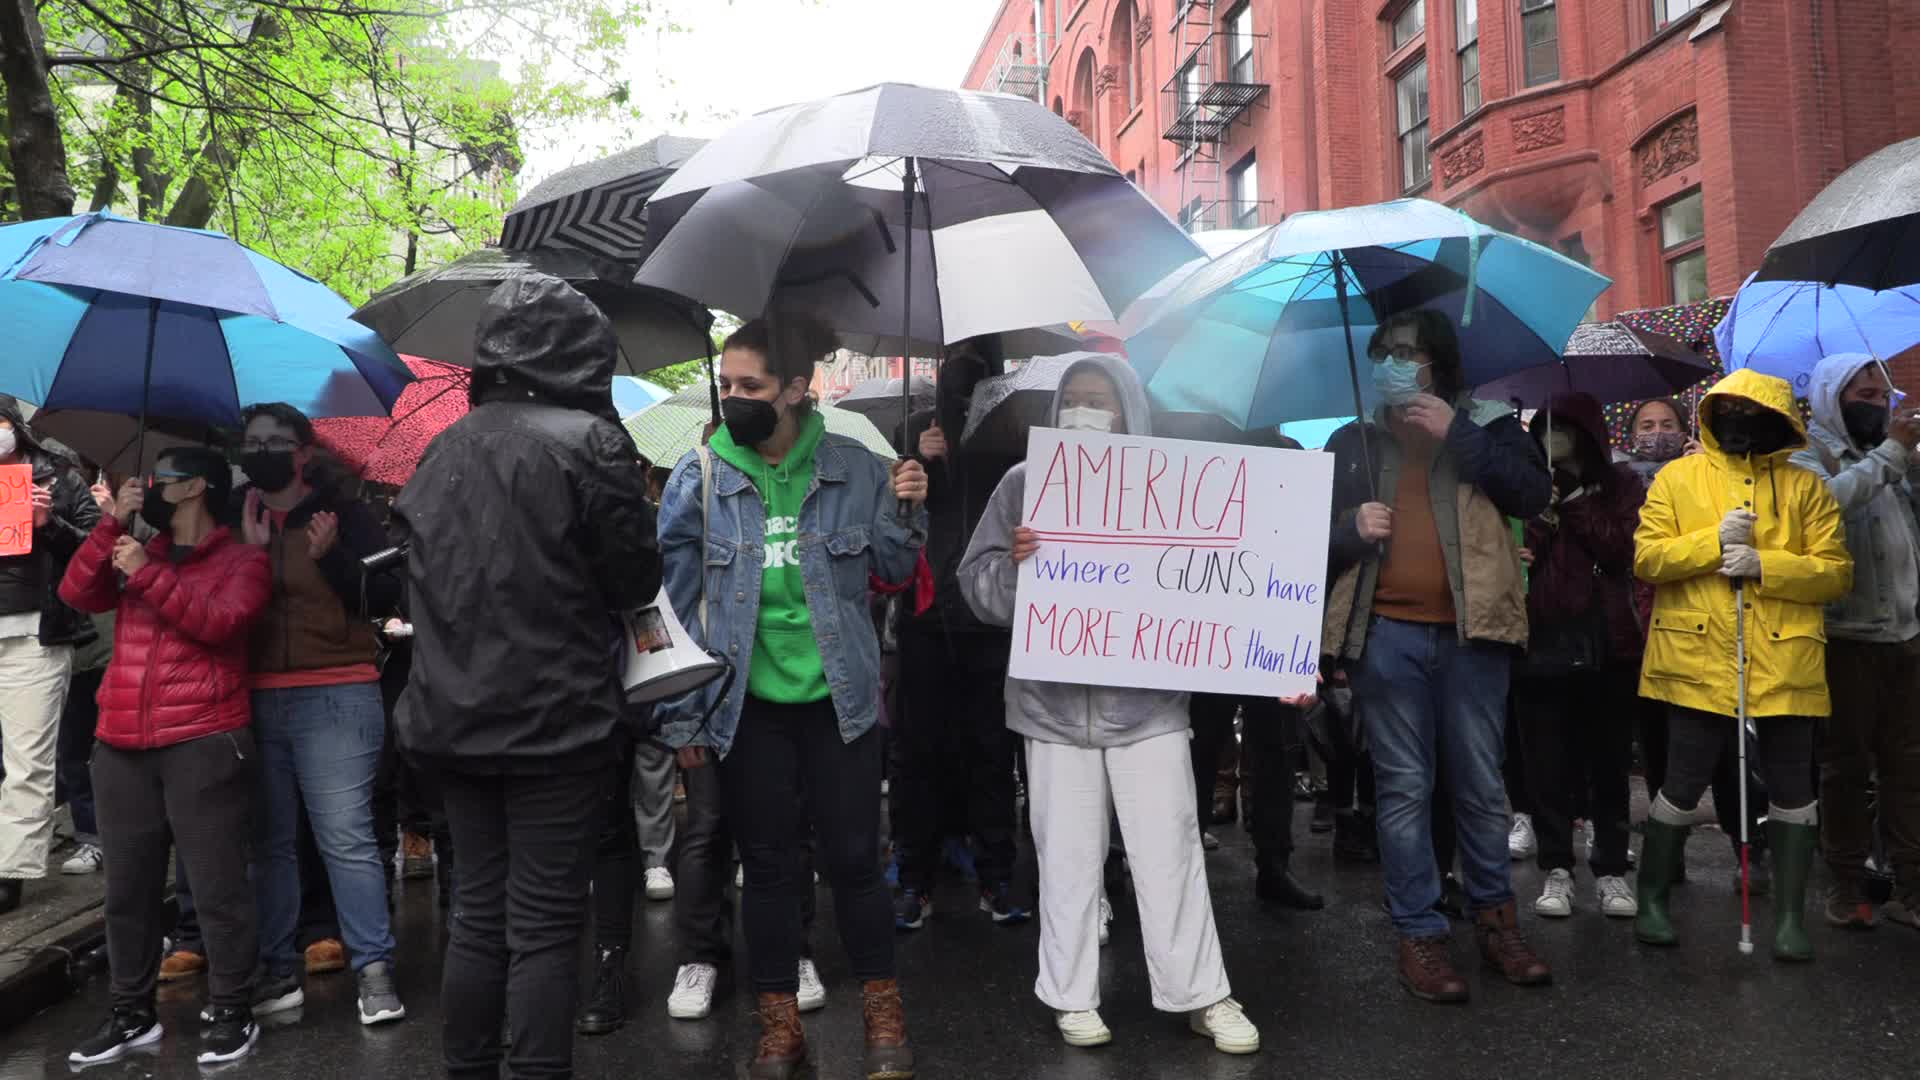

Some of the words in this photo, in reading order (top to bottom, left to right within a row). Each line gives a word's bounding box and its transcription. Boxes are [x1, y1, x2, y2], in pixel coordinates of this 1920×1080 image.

[1029, 441, 1246, 537] AMERICA
[1035, 549, 1131, 585] where
[1156, 544, 1260, 597] GUNS
[1266, 562, 1318, 605] have
[1025, 602, 1124, 657] MORE
[1131, 612, 1237, 670] RIGHTS
[1244, 628, 1285, 674] than
[1288, 633, 1300, 673] I
[1295, 640, 1317, 676] do
